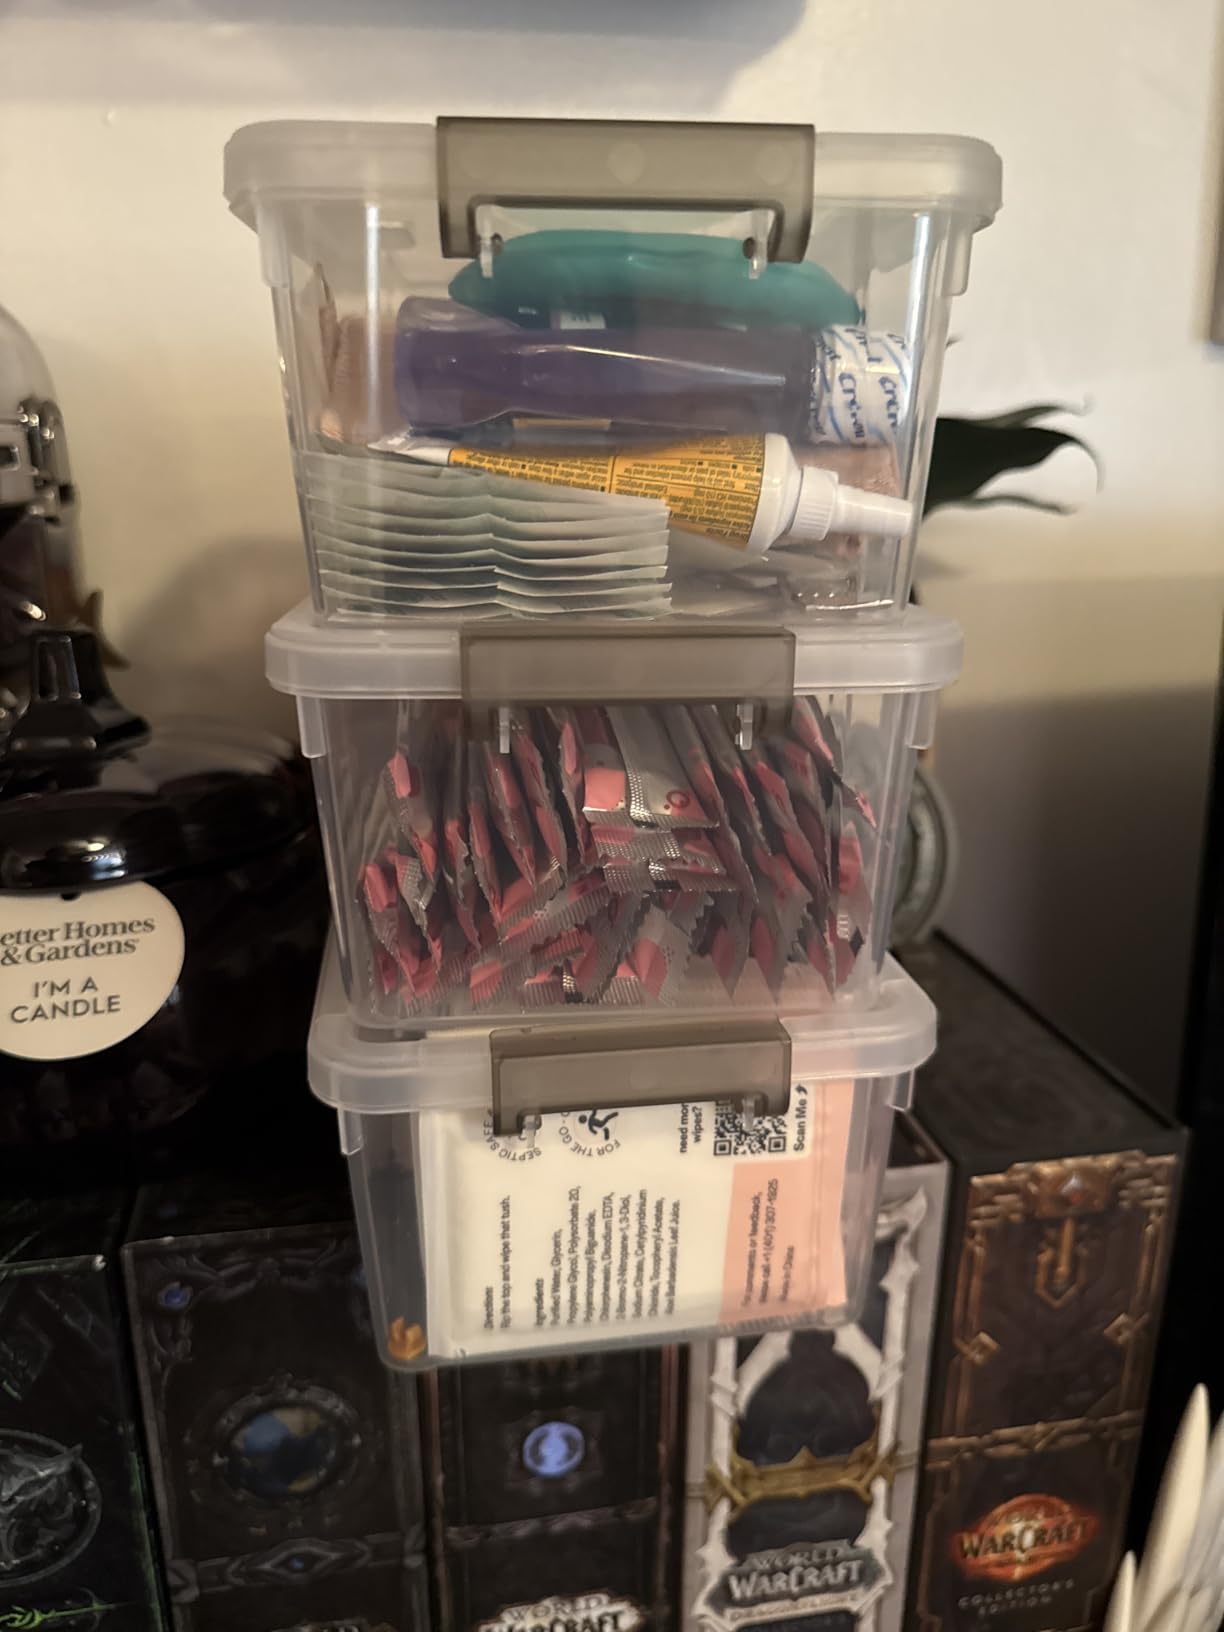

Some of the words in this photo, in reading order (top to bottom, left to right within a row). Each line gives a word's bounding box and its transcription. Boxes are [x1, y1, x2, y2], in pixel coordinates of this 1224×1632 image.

[0, 928, 60, 947] etter
[64, 918, 156, 941] Homes
[33, 978, 71, 998] I'M
[80, 976, 99, 994] A
[10, 995, 121, 1024] CANDLE
[681, 1103, 690, 1125] mor
[797, 1098, 808, 1119] Me
[558, 1126, 573, 1145] GO
[693, 1106, 704, 1144] wipes?
[794, 1120, 807, 1152] Scan
[570, 1142, 593, 1158] THE
[597, 1139, 621, 1157] FOR
[679, 1127, 688, 1154] need
[499, 1146, 543, 1162] SEPTIC
[568, 1185, 580, 1201] 20,
[501, 1196, 510, 1218] tush.
[603, 1192, 614, 1218] EDTA,
[500, 1220, 510, 1239] that
[568, 1203, 580, 1253] Polysorbate
[501, 1241, 511, 1263] wipe
[500, 1265, 510, 1281] and
[501, 1285, 511, 1298] top
[501, 1300, 509, 1314] the
[752, 1545, 846, 1570] WORLD
[728, 1560, 862, 1600] WARCRAFT
[508, 1595, 604, 1621] WORLD
